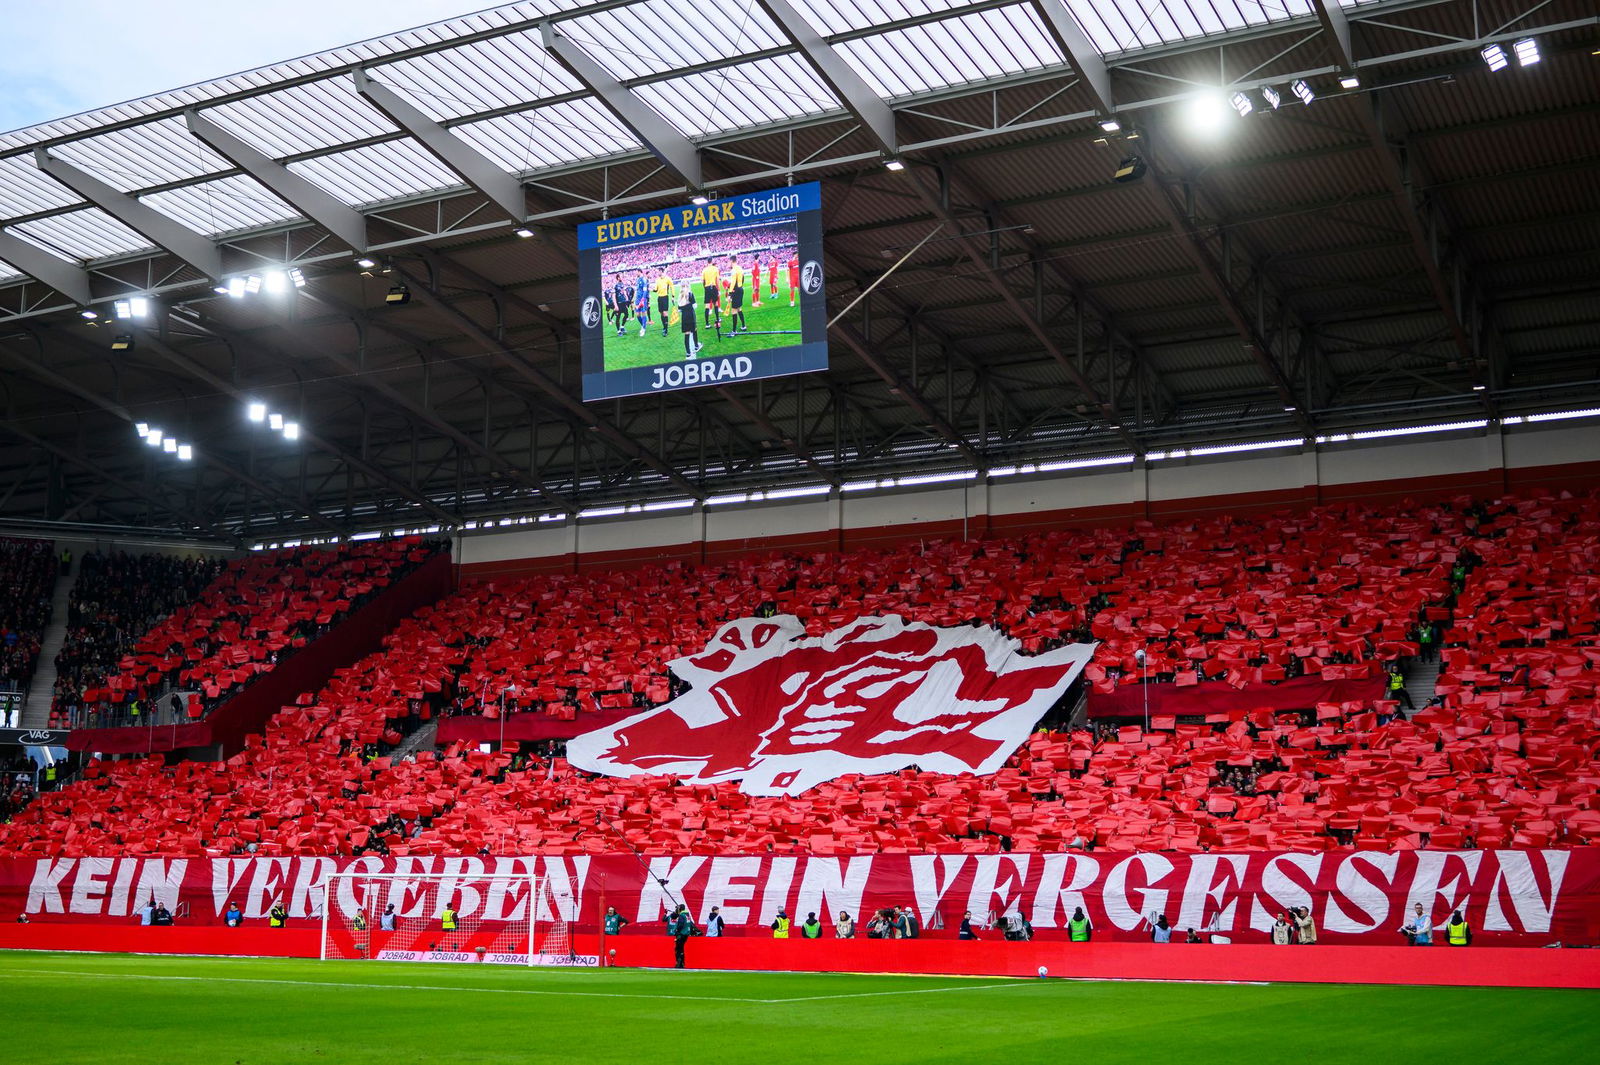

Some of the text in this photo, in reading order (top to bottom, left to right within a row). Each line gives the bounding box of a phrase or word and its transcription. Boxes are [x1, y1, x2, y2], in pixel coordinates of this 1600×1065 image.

[596, 191, 800, 243] EUROPA PARK Stadion
[651, 356, 753, 389] JOBRAD
[29, 730, 50, 739] VAG
[24, 848, 1572, 933] KEIN VERGEBEN KEIN VERGESSEN
[382, 951, 416, 960] JOBRAD
[428, 952, 469, 962] JOBRAD
